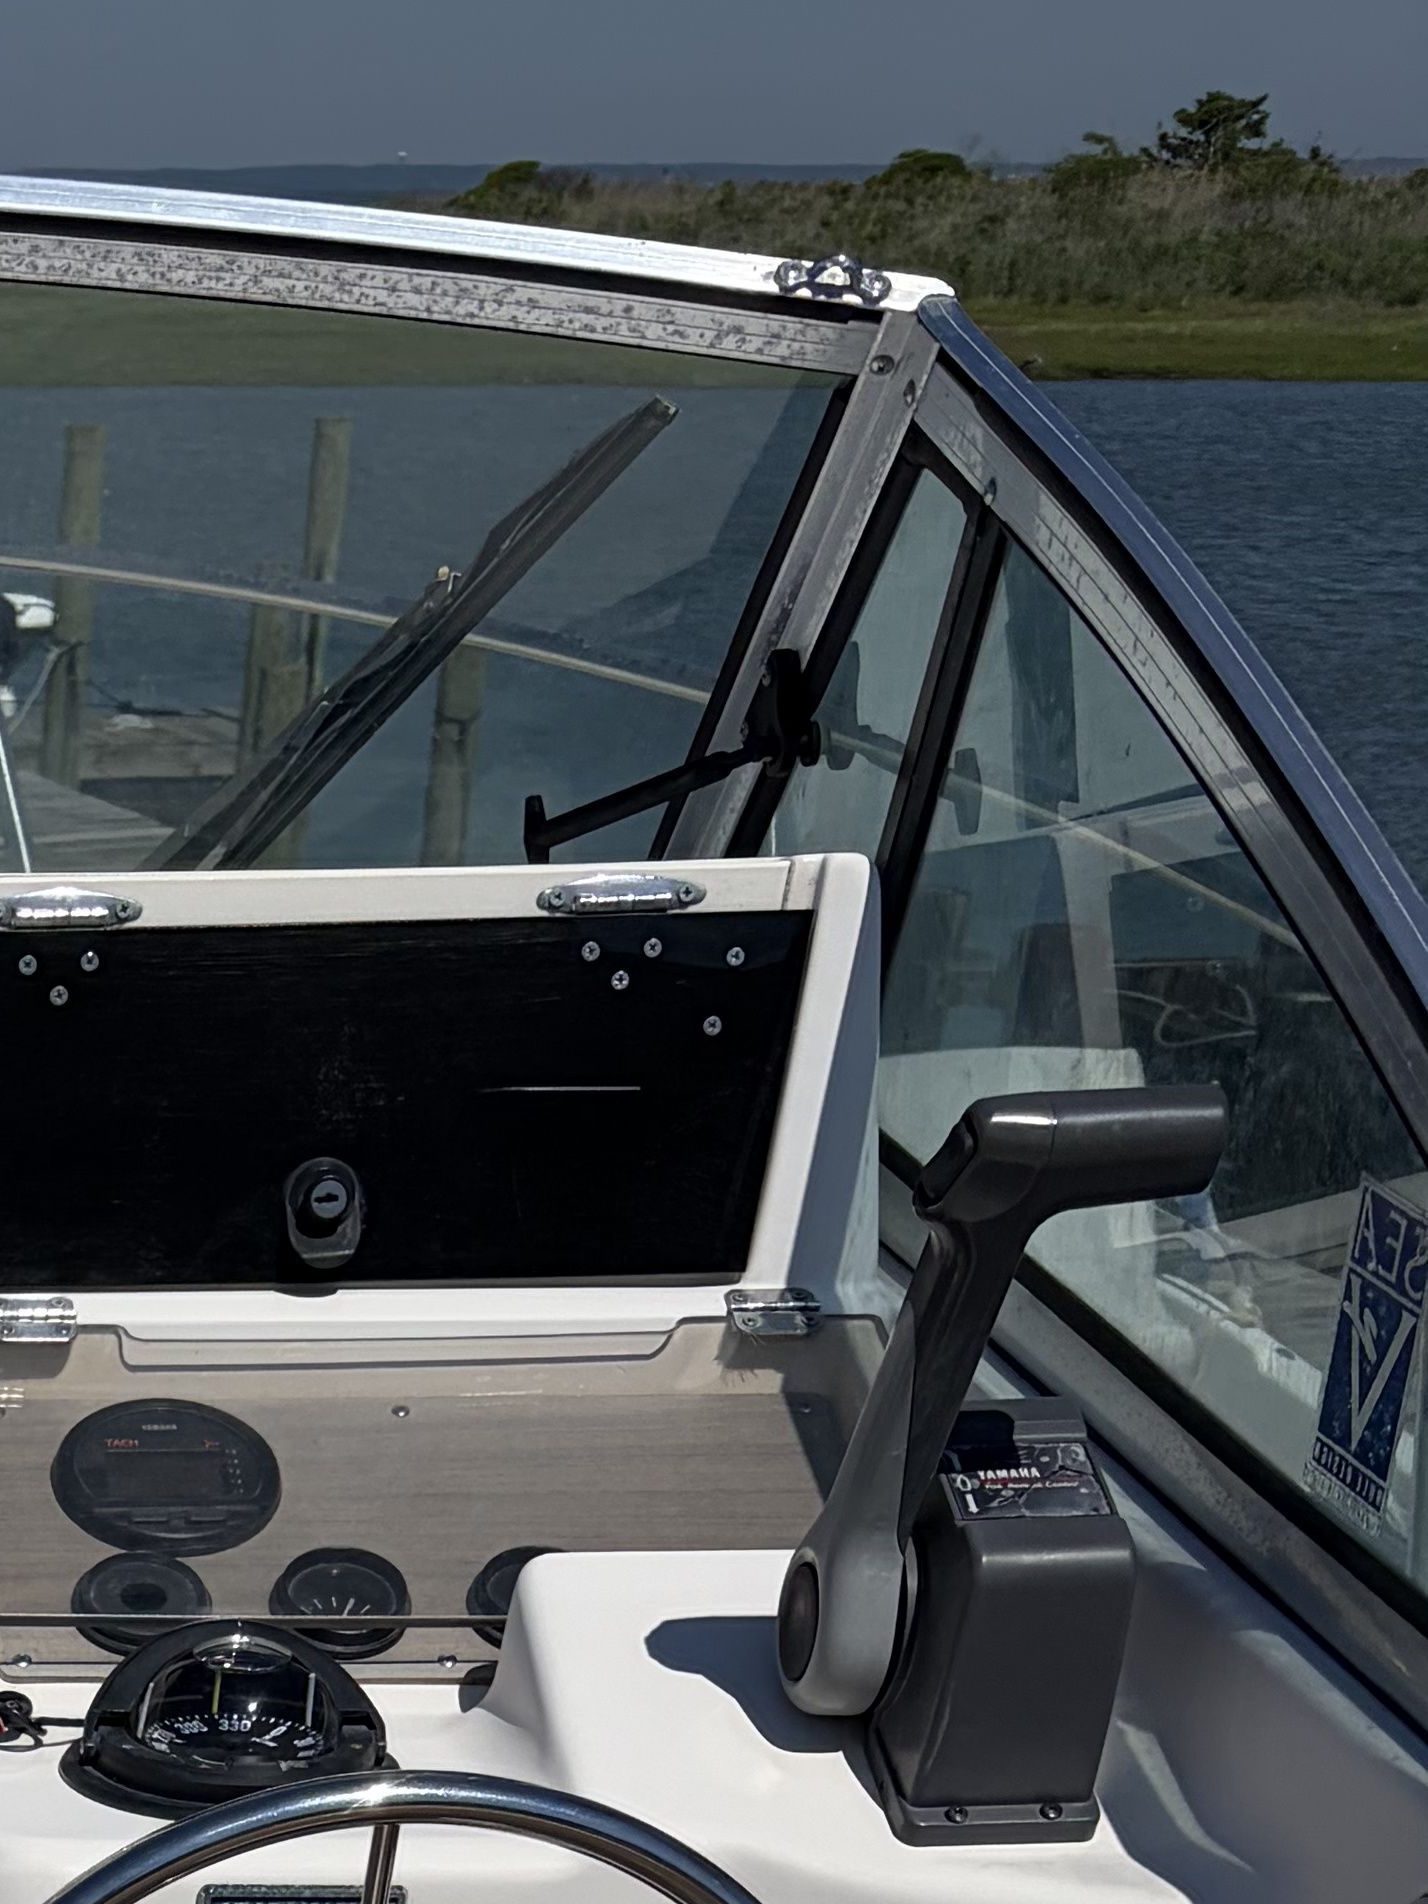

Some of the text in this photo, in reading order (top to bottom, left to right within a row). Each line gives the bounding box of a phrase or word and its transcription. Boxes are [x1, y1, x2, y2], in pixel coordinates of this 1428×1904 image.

[105, 1439, 139, 1447] TACH
[977, 1467, 1040, 1479] YAMAHA
[174, 1719, 251, 1734] 300 330
